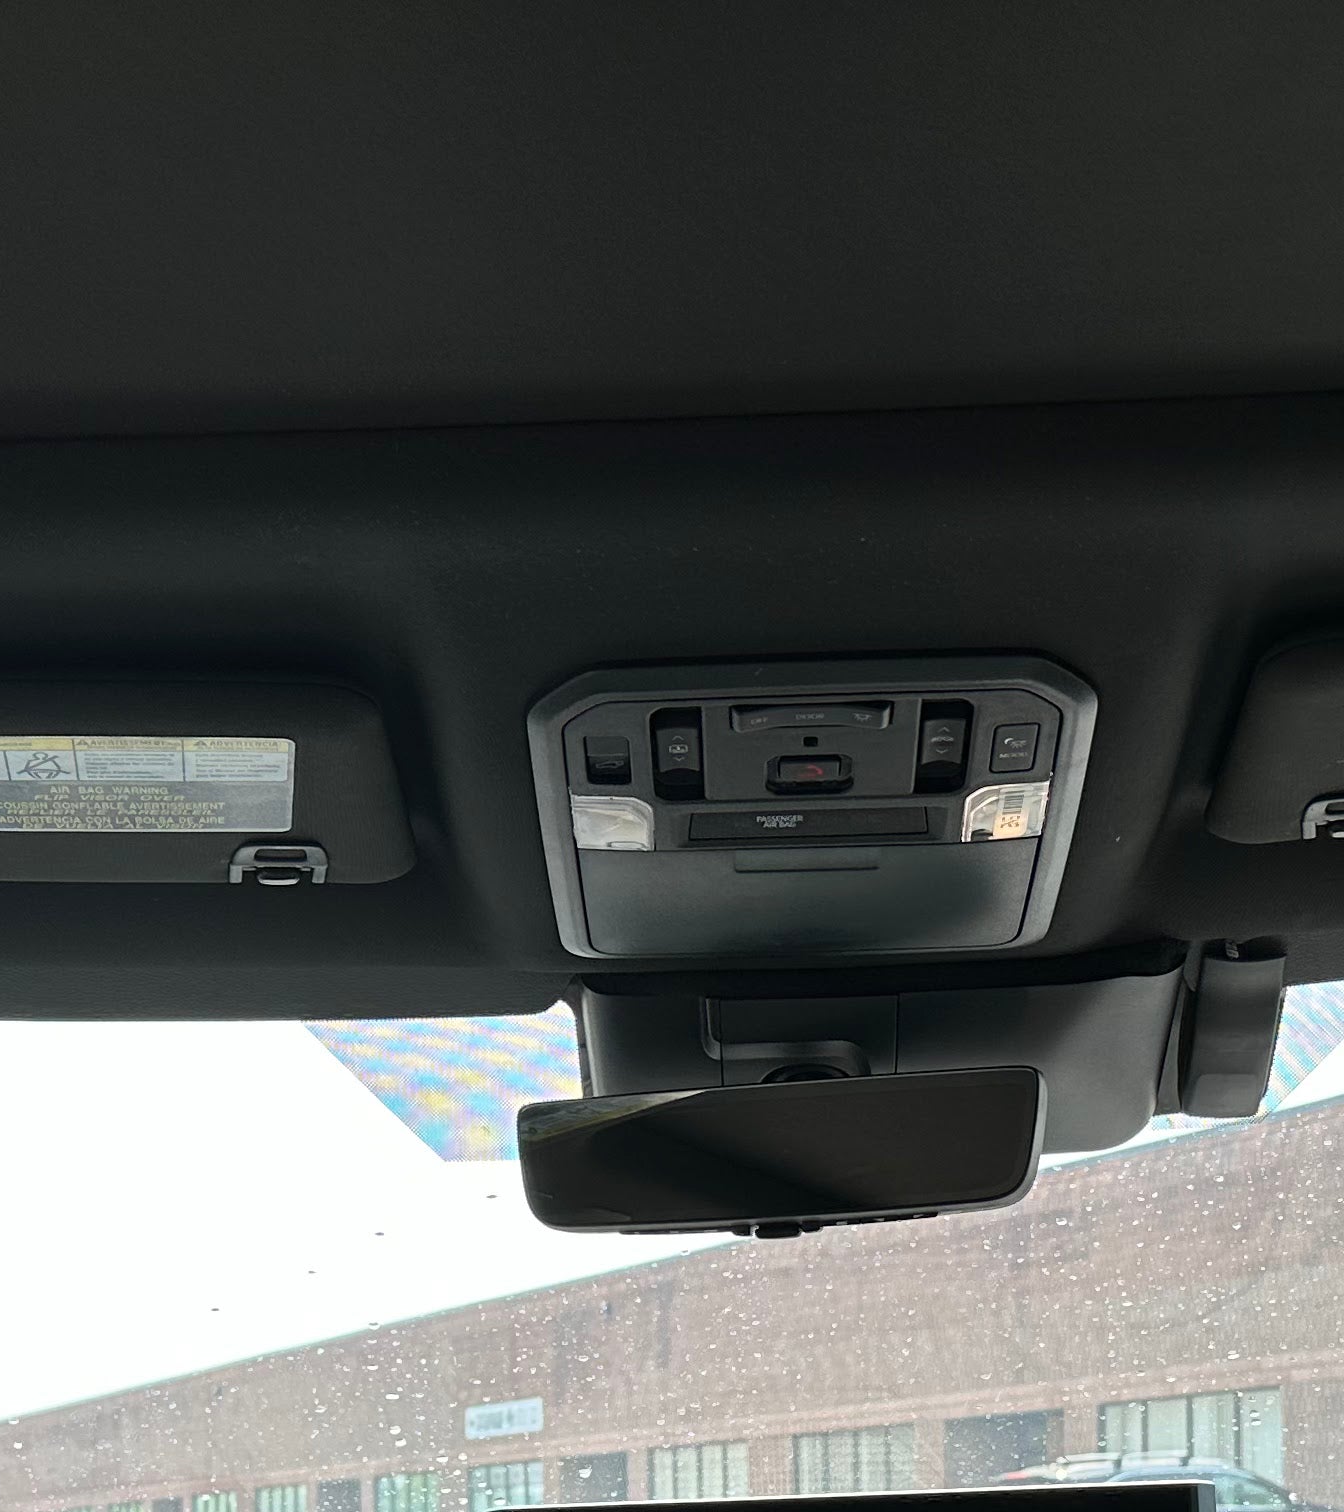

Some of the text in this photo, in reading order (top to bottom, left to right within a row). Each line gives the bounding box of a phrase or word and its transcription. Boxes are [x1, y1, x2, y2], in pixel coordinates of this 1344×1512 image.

[49, 786, 168, 794] AIR BAG WARNING
[129, 802, 225, 810] AVERTISSEMENT
[86, 816, 111, 824] CON
[116, 816, 132, 824] LA
